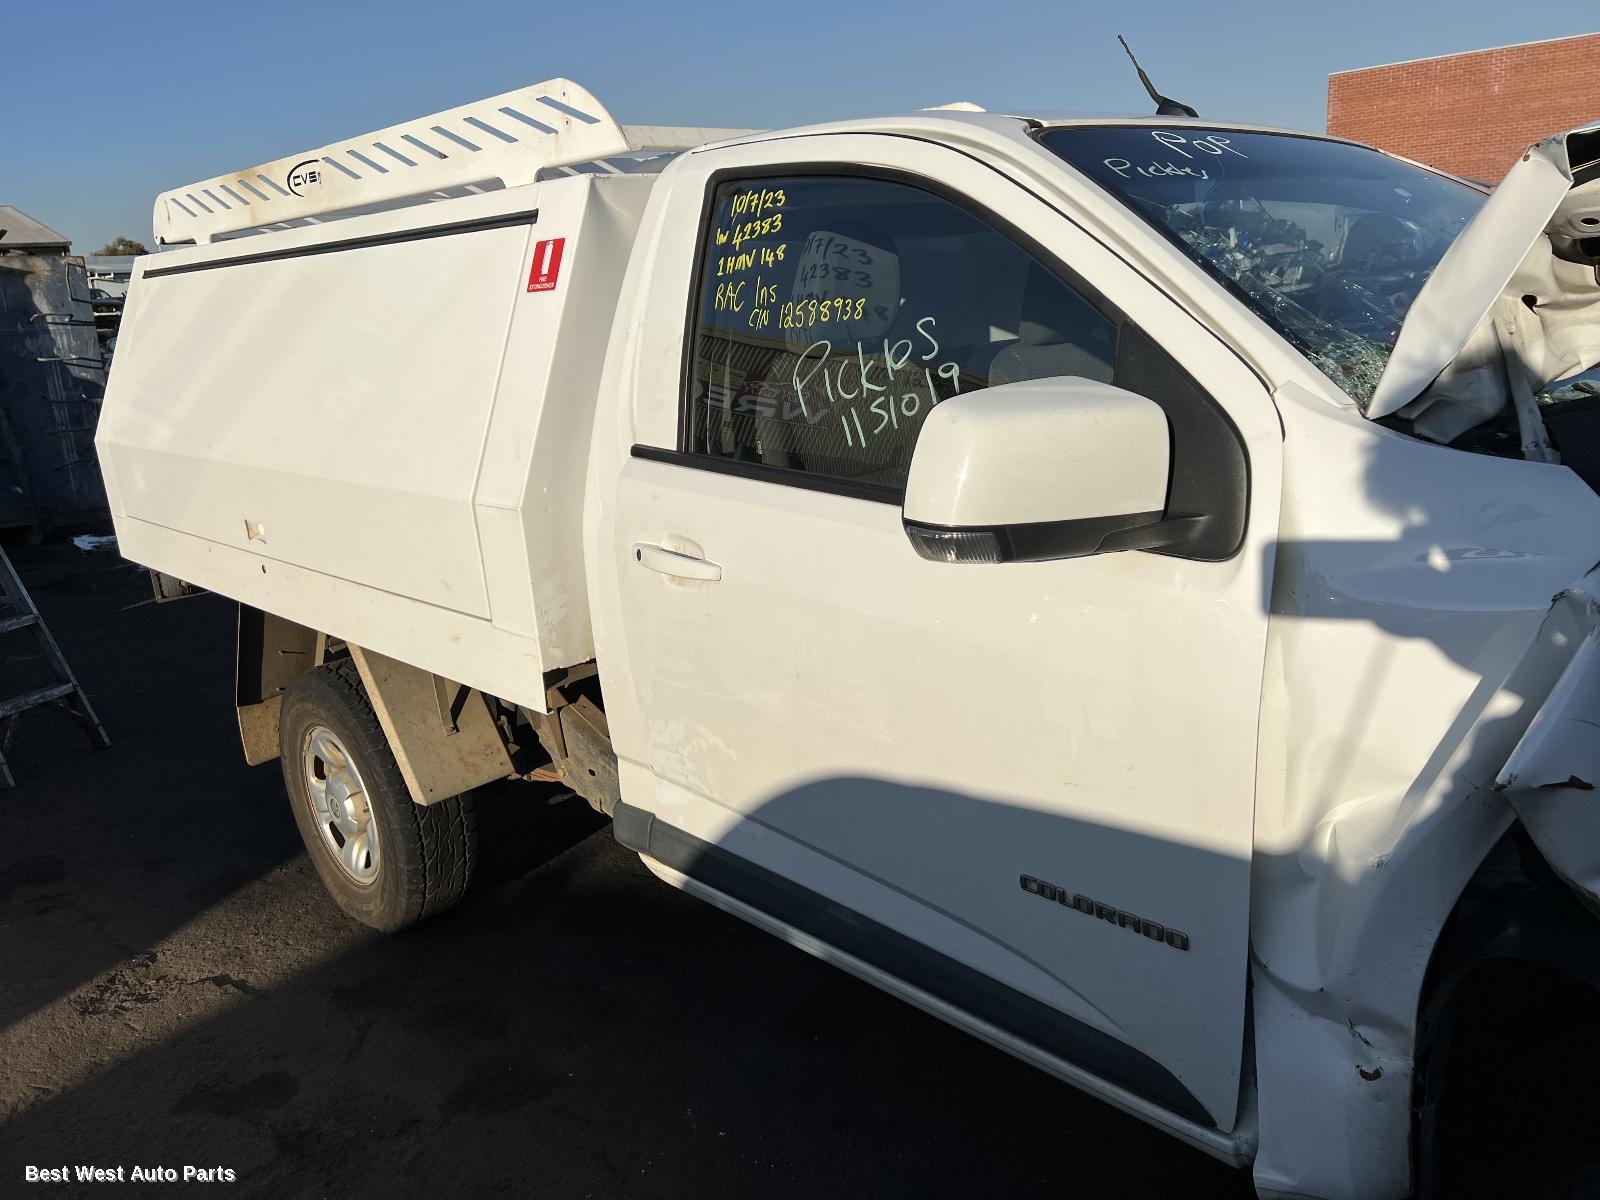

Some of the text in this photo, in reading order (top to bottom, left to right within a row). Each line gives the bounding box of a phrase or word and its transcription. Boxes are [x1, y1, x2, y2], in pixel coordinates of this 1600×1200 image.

[731, 189, 786, 217] 10/7/23
[732, 213, 783, 251] 42383
[761, 244, 787, 267] 148
[715, 281, 746, 312] RAC
[778, 298, 866, 329] 12588938
[1019, 873, 1190, 951] COLORADO
